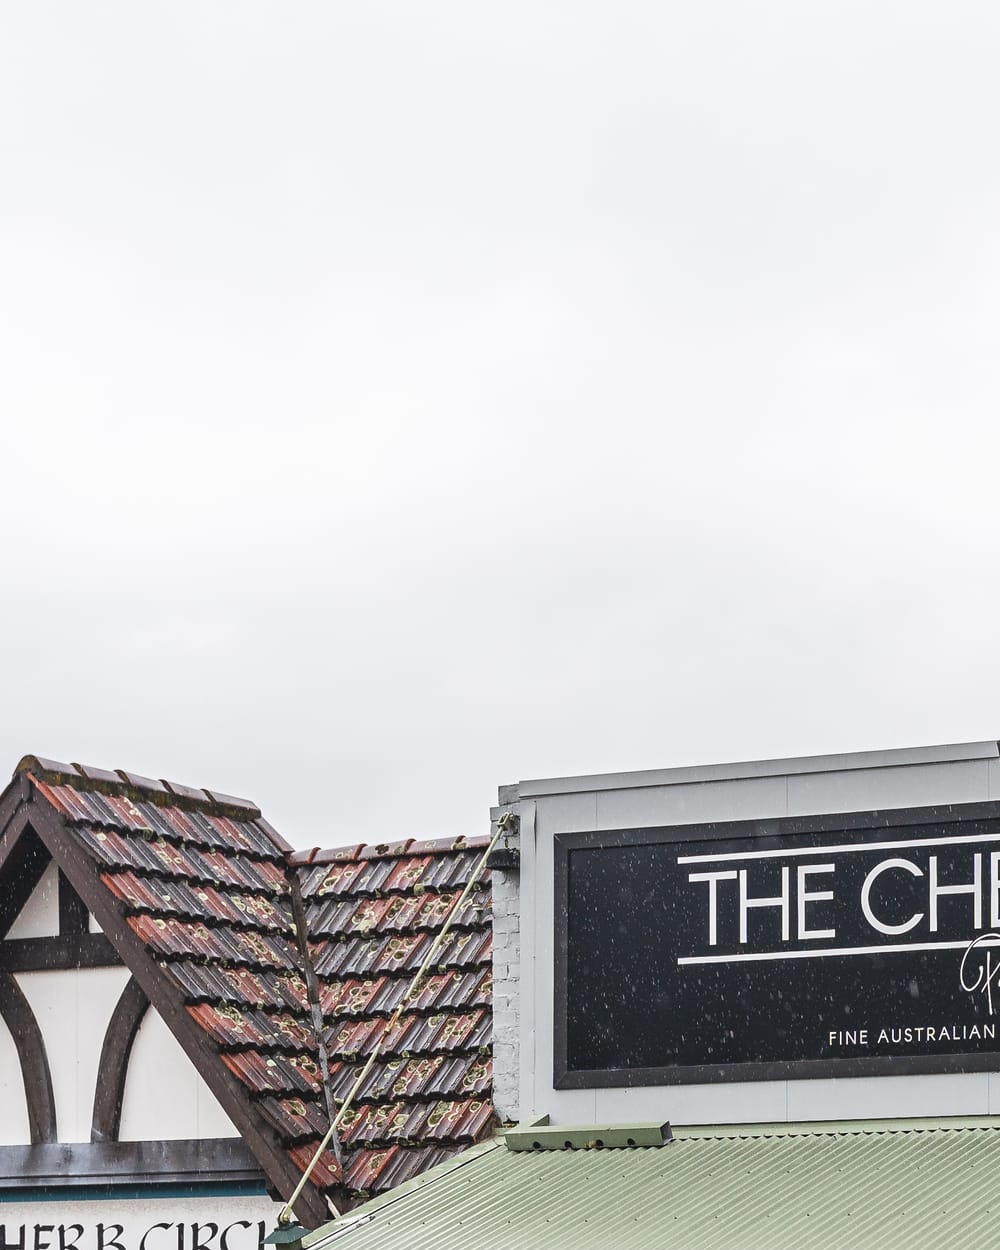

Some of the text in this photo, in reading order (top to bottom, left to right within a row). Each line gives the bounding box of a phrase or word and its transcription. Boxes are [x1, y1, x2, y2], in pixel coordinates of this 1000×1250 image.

[688, 863, 836, 945] THE
[829, 1030, 868, 1046] FINE
[877, 1023, 996, 1043] AUSTRALIAN
